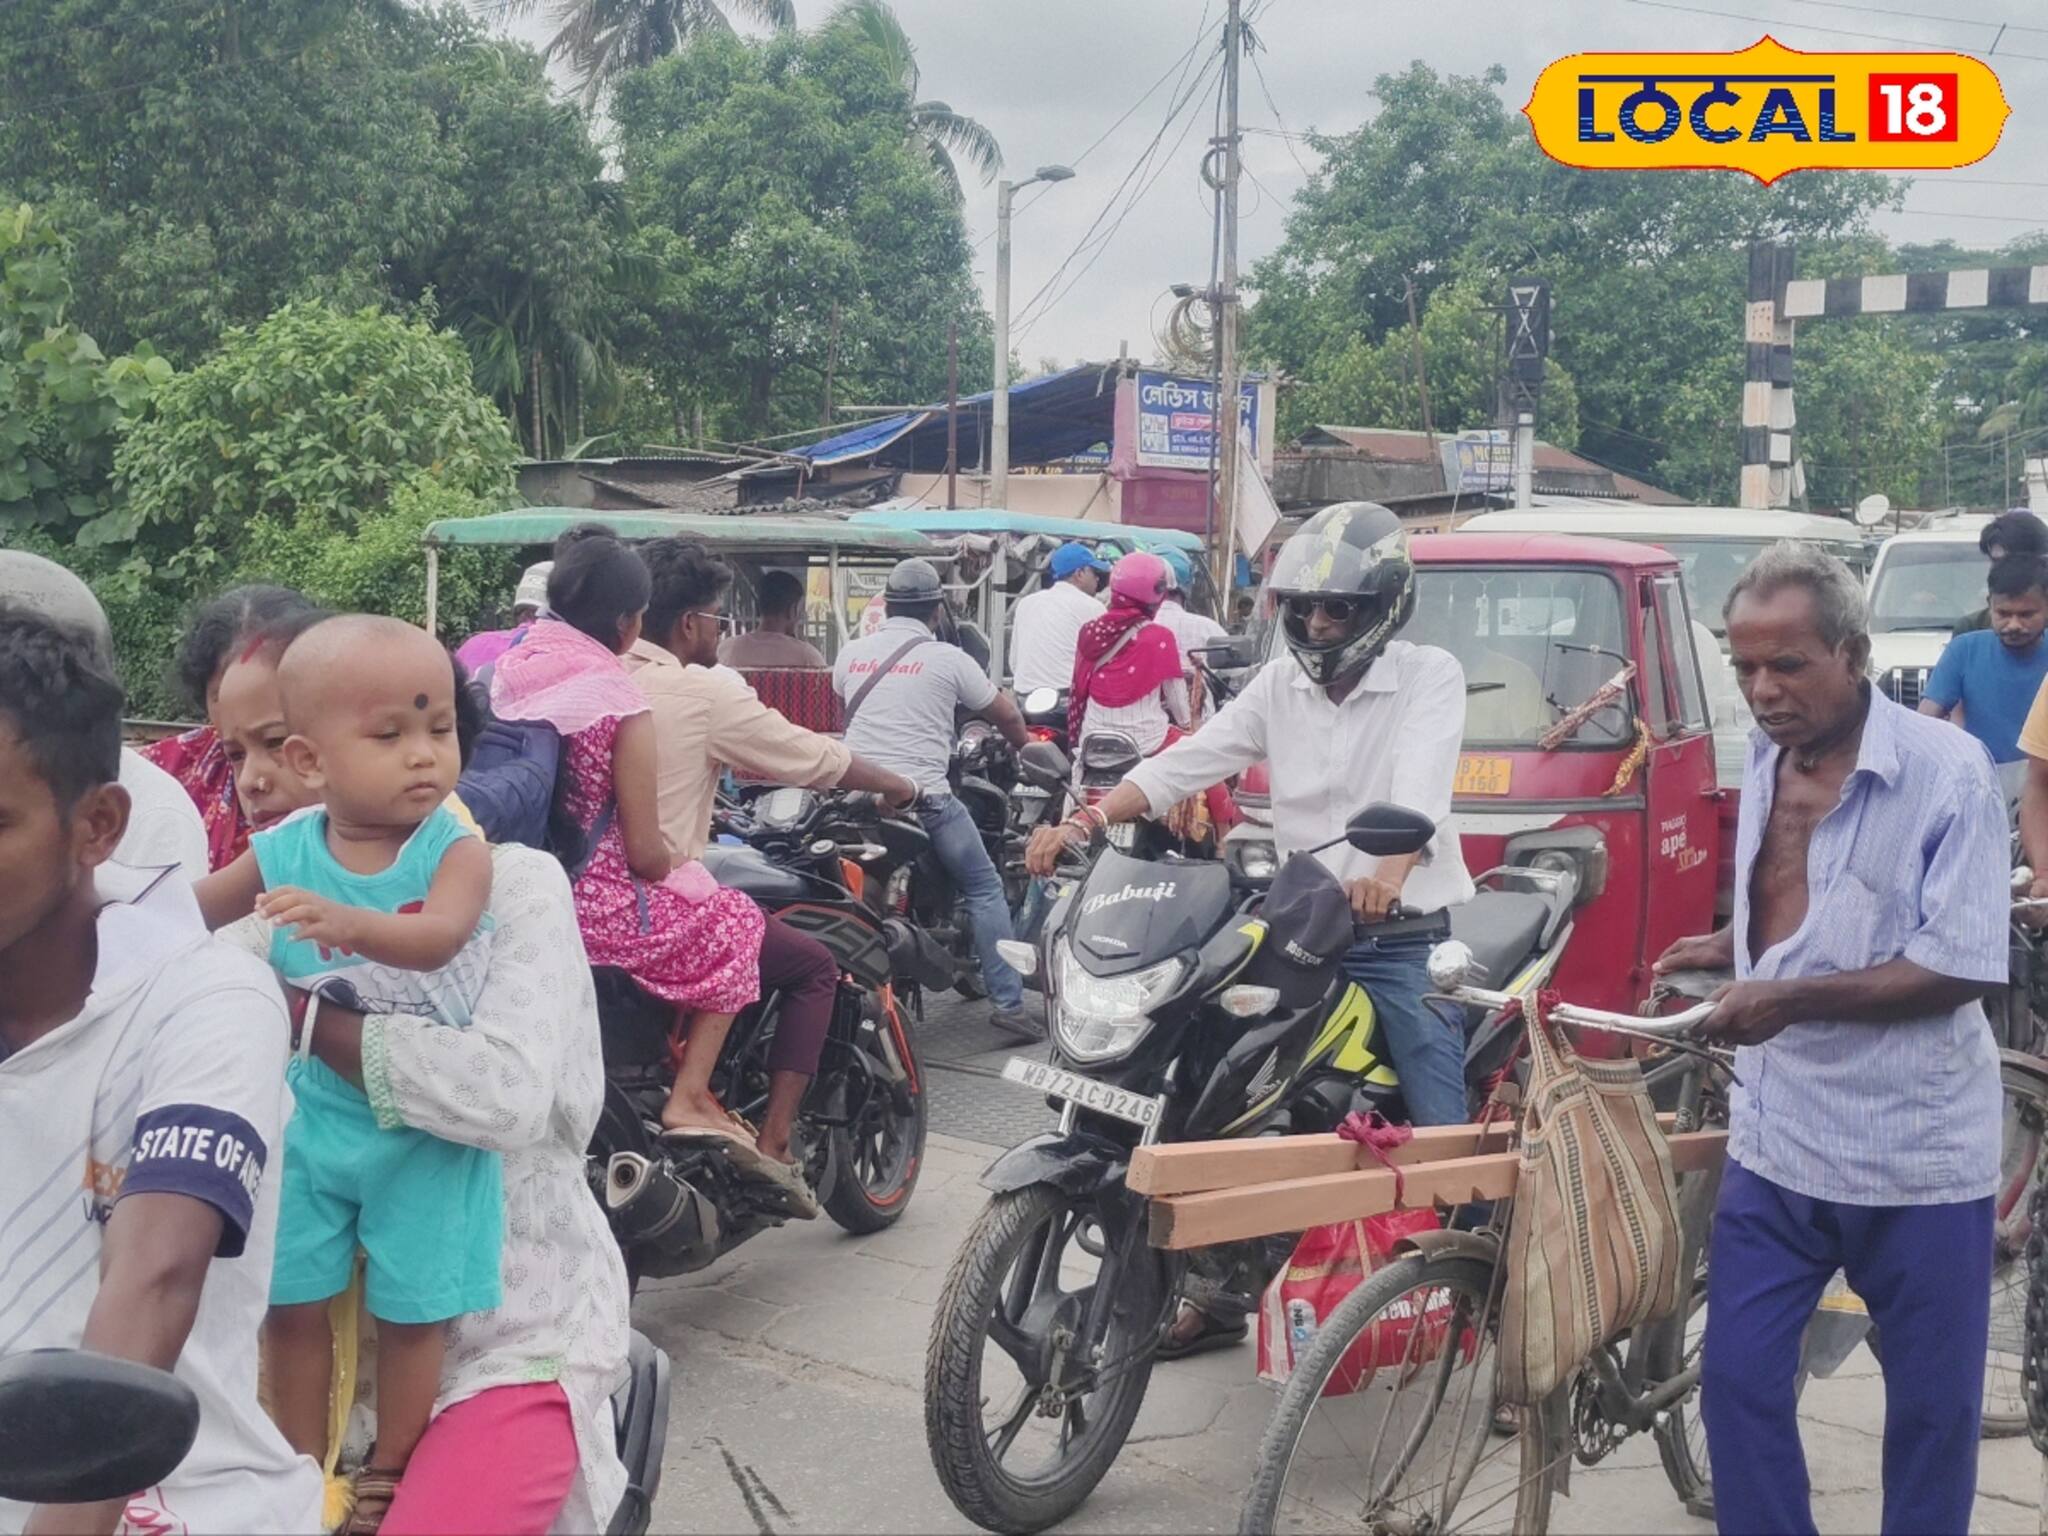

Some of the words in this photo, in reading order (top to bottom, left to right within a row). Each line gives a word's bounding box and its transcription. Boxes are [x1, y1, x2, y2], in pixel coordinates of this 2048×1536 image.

[848, 658, 925, 676] bahbali
[1083, 881, 1177, 915] Babuji
[1091, 935, 1128, 949] HONDA
[214, 1134, 244, 1171] OF
